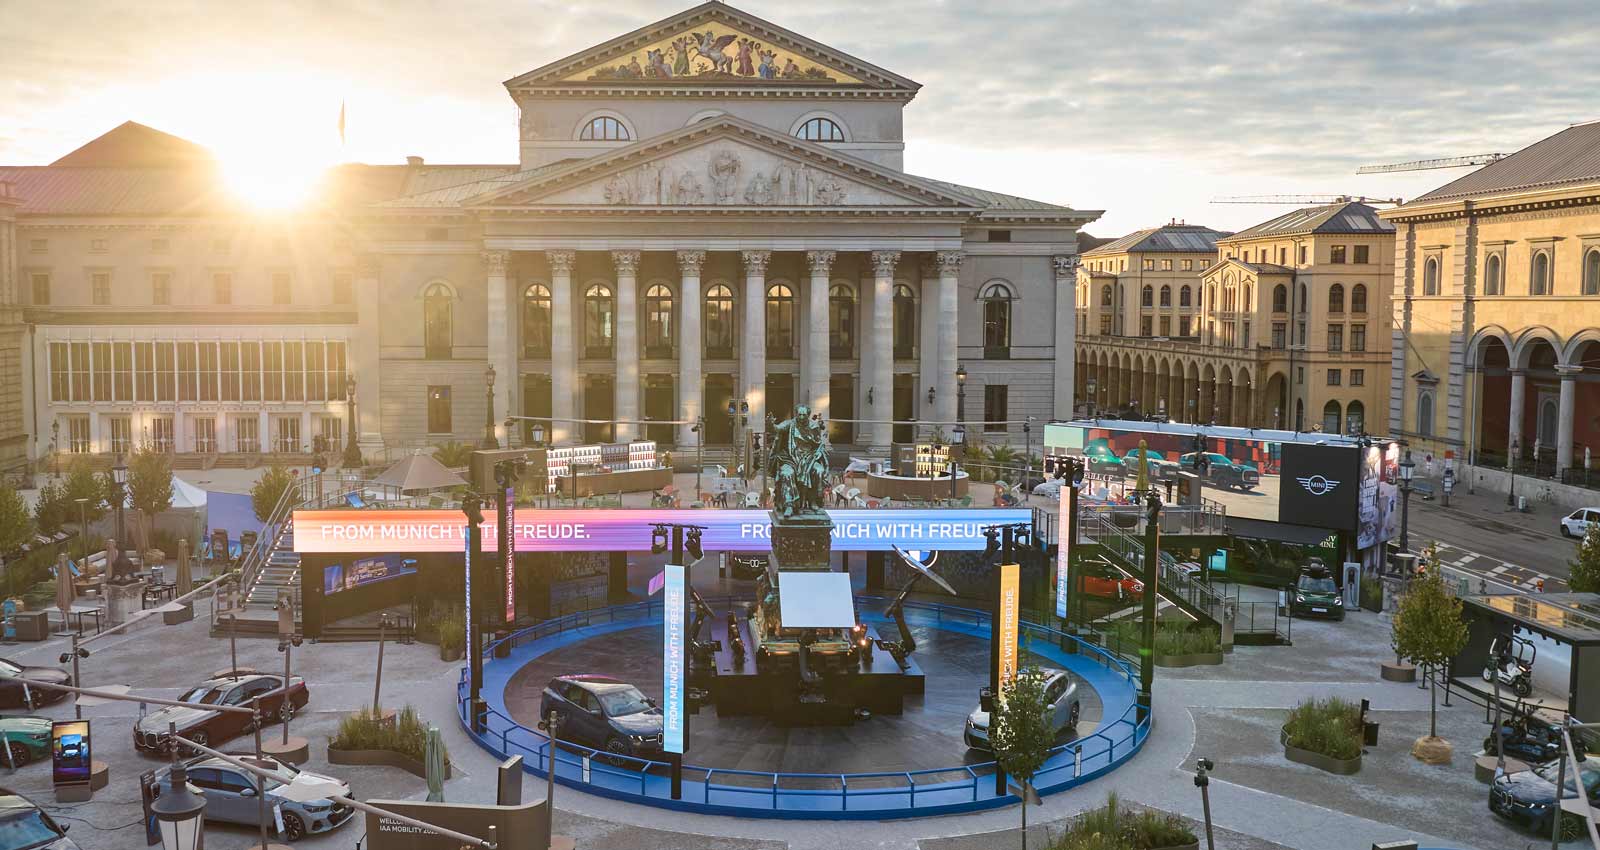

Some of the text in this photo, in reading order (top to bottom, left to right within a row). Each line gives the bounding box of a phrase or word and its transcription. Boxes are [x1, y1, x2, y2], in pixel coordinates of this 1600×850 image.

[1310, 481, 1325, 489] MINI
[321, 524, 374, 540] FROM
[381, 524, 452, 540] MUNICH
[512, 524, 590, 540] FREUDE.
[829, 523, 870, 539] NICH
[876, 523, 922, 539] WITH
[670, 632, 679, 658] WITH
[1004, 631, 1013, 658] WITH
[669, 660, 679, 699] MUNICH
[669, 701, 679, 730] FROM
